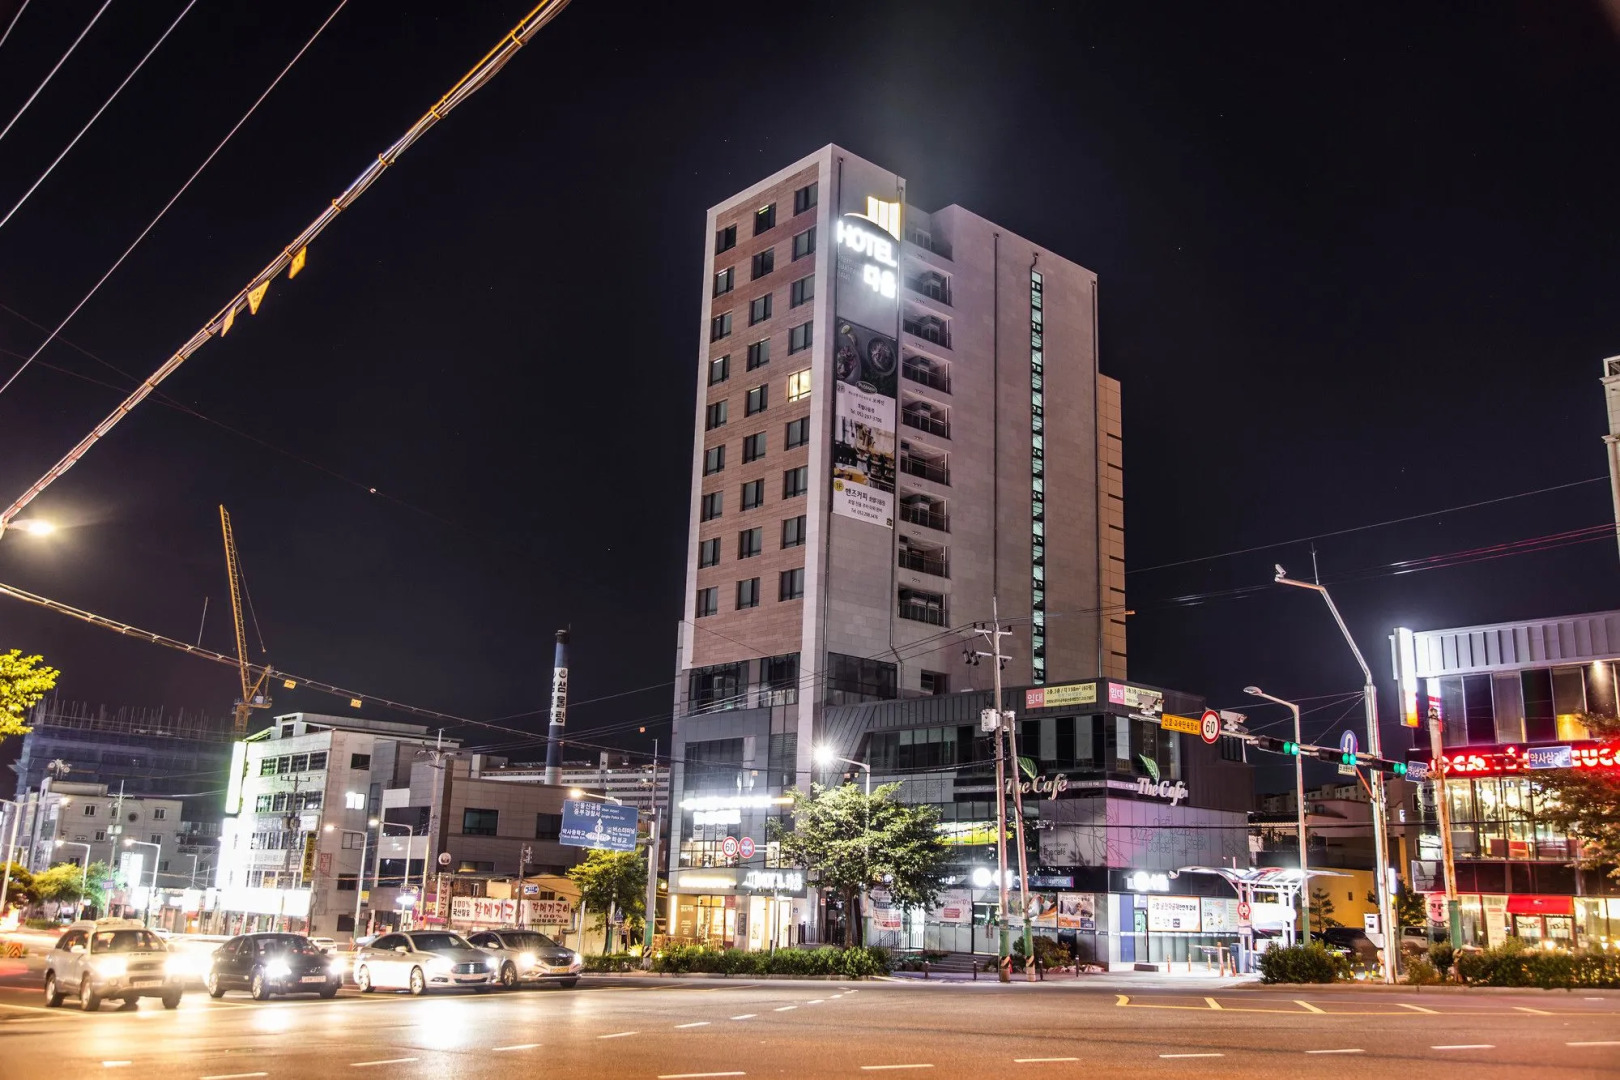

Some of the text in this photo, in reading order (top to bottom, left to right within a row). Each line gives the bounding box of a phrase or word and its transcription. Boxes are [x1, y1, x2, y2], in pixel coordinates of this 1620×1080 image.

[837, 221, 897, 267] HOTEL
[845, 488, 868, 501] 핸즈커피
[1027, 692, 1043, 704] 임대
[1110, 688, 1125, 700] 임대
[1206, 721, 1215, 733] 60
[1530, 752, 1571, 764] 약사삼거리
[1137, 777, 1158, 796] The
[725, 842, 735, 852] 60
[453, 900, 471, 908] 100%
